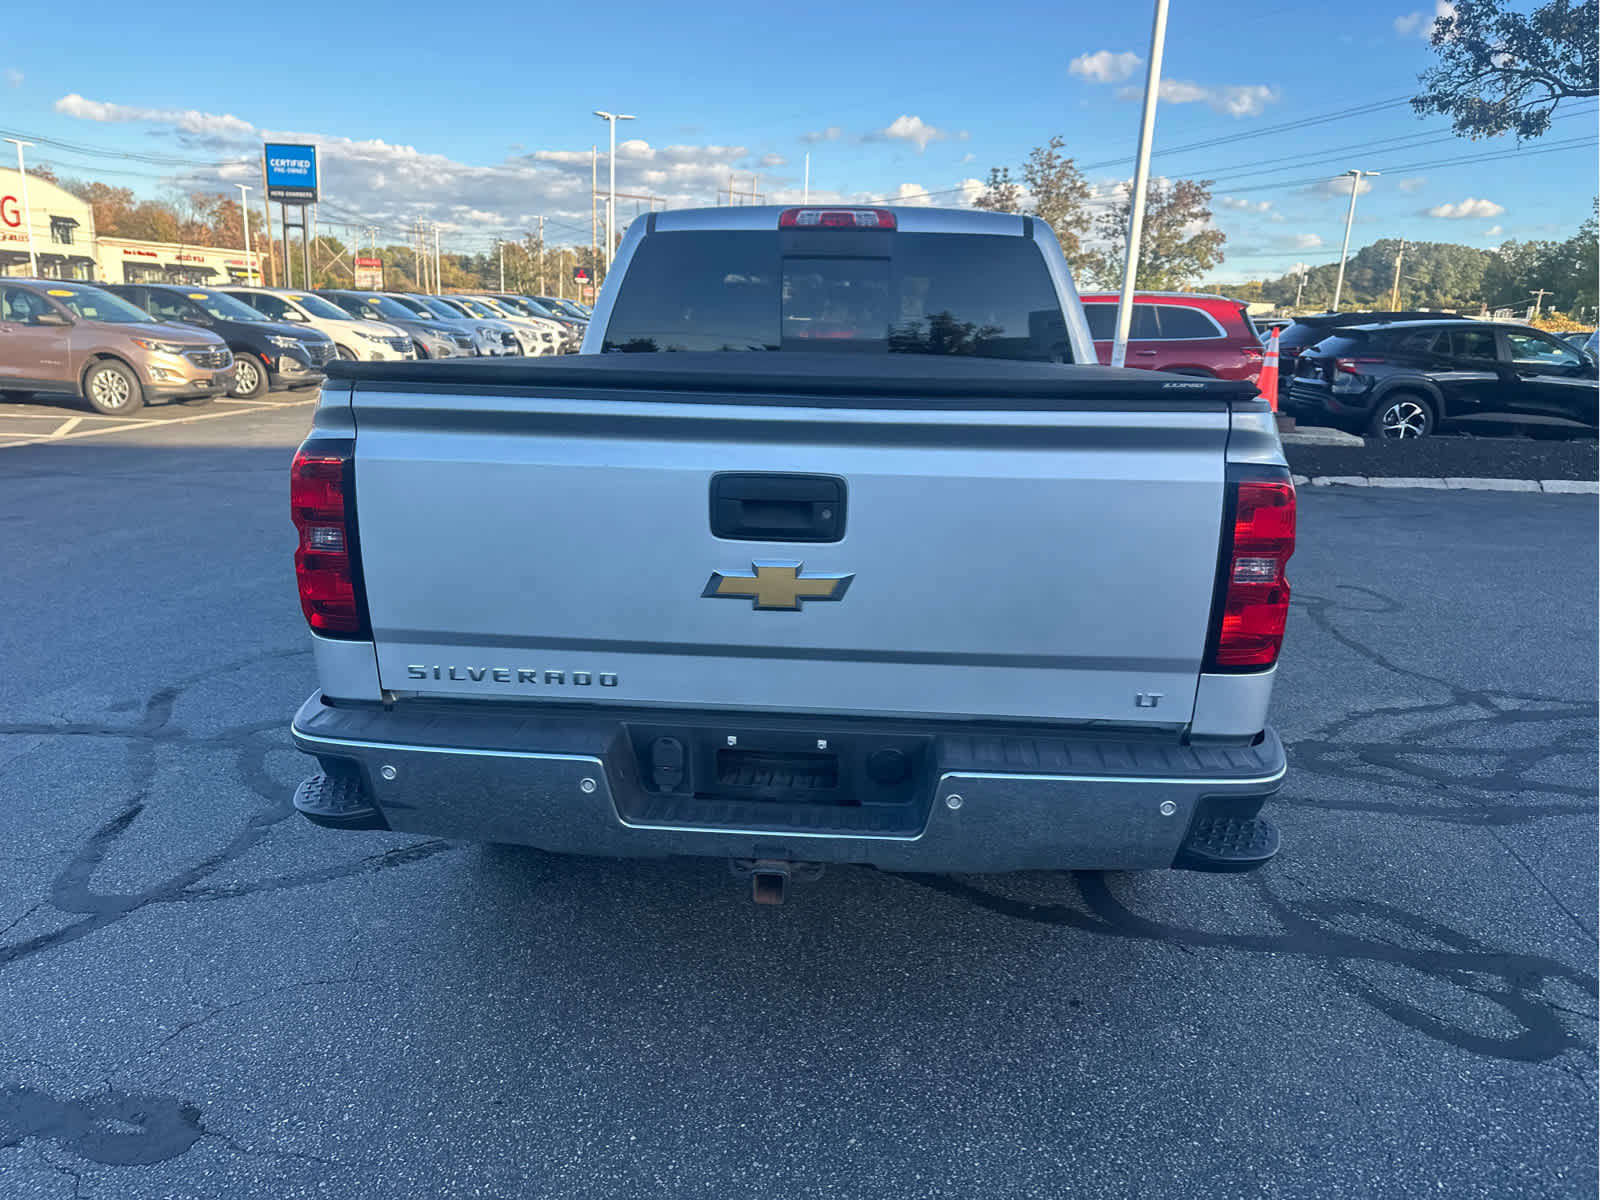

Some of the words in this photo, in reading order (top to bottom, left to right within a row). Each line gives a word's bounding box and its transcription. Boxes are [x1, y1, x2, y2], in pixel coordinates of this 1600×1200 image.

[270, 158, 311, 168] CERTIFIED
[273, 167, 308, 175] PRE-OWNED
[407, 664, 619, 687] SILVERADO
[1135, 692, 1165, 708] LT
